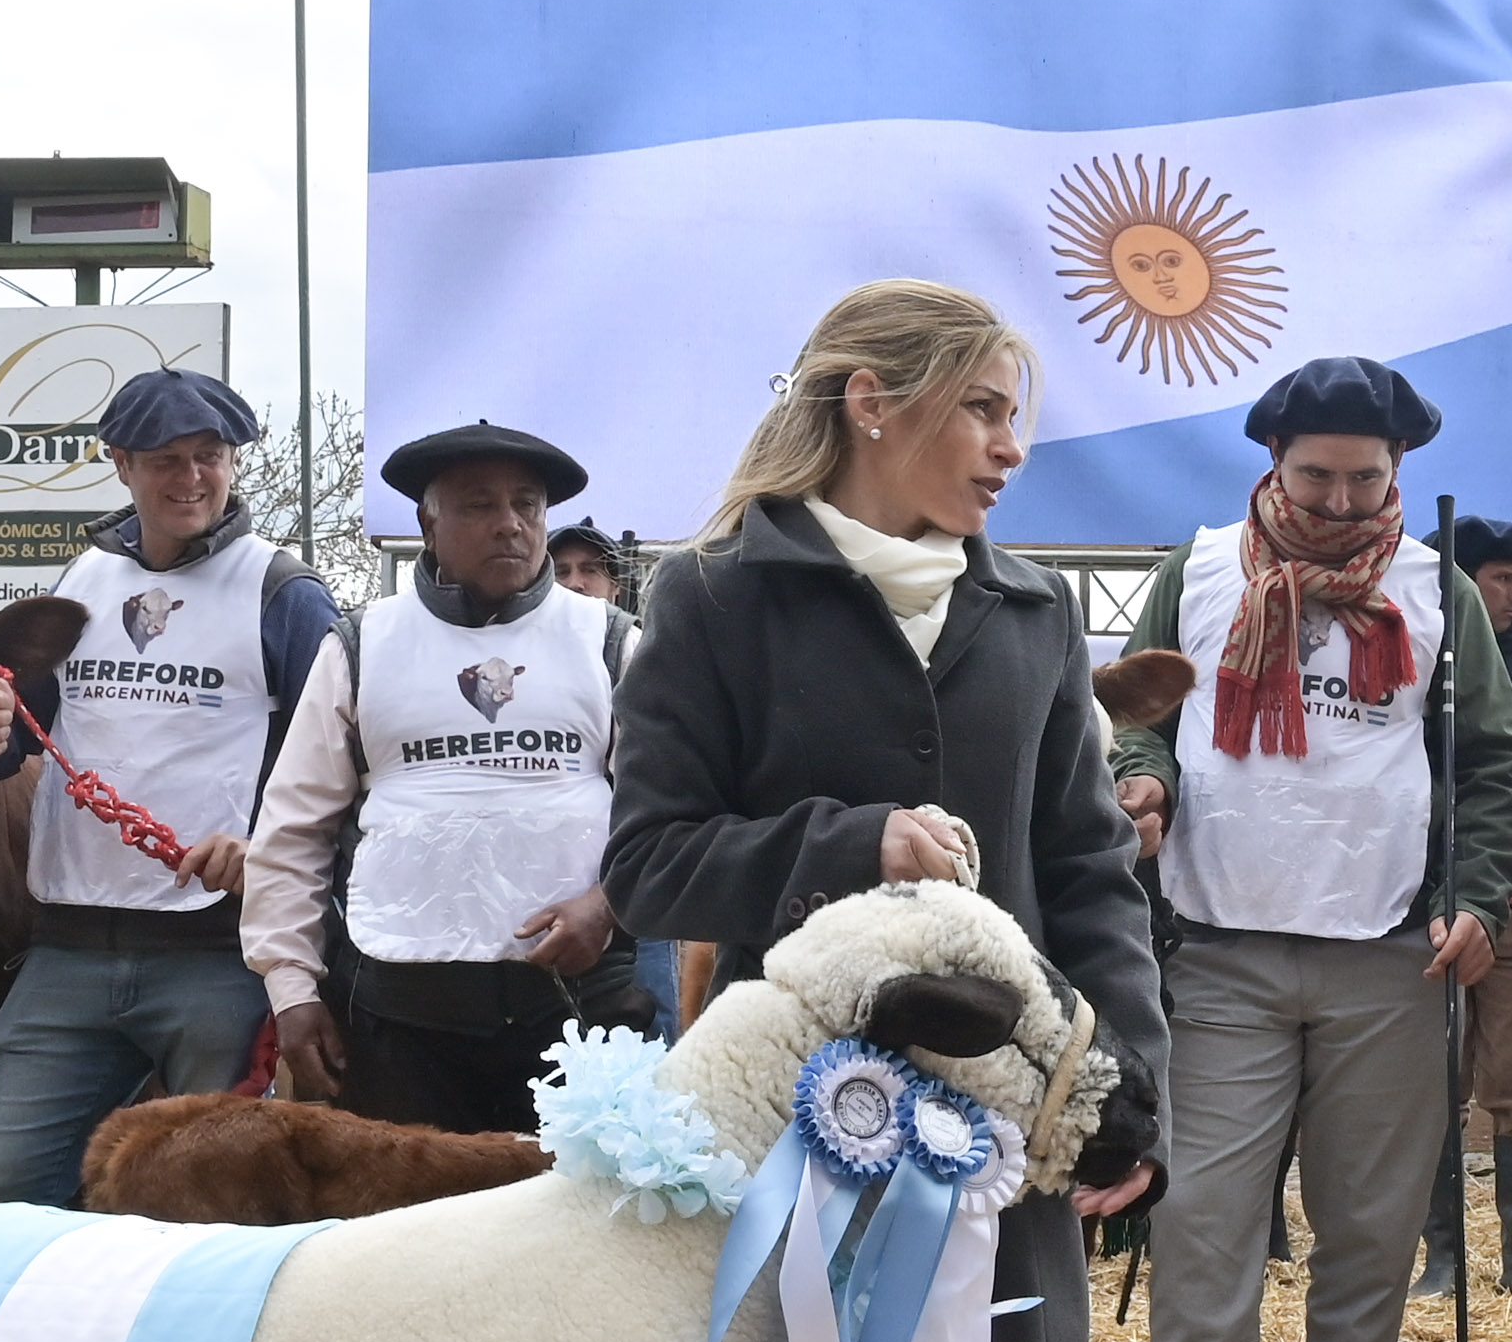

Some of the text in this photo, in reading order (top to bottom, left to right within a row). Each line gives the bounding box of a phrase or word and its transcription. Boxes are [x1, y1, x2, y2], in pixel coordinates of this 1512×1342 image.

[20, 544, 36, 558] &
[65, 659, 225, 690] HEREFORD
[83, 685, 190, 705] ARGENTINA
[401, 730, 582, 764] HEREFORD
